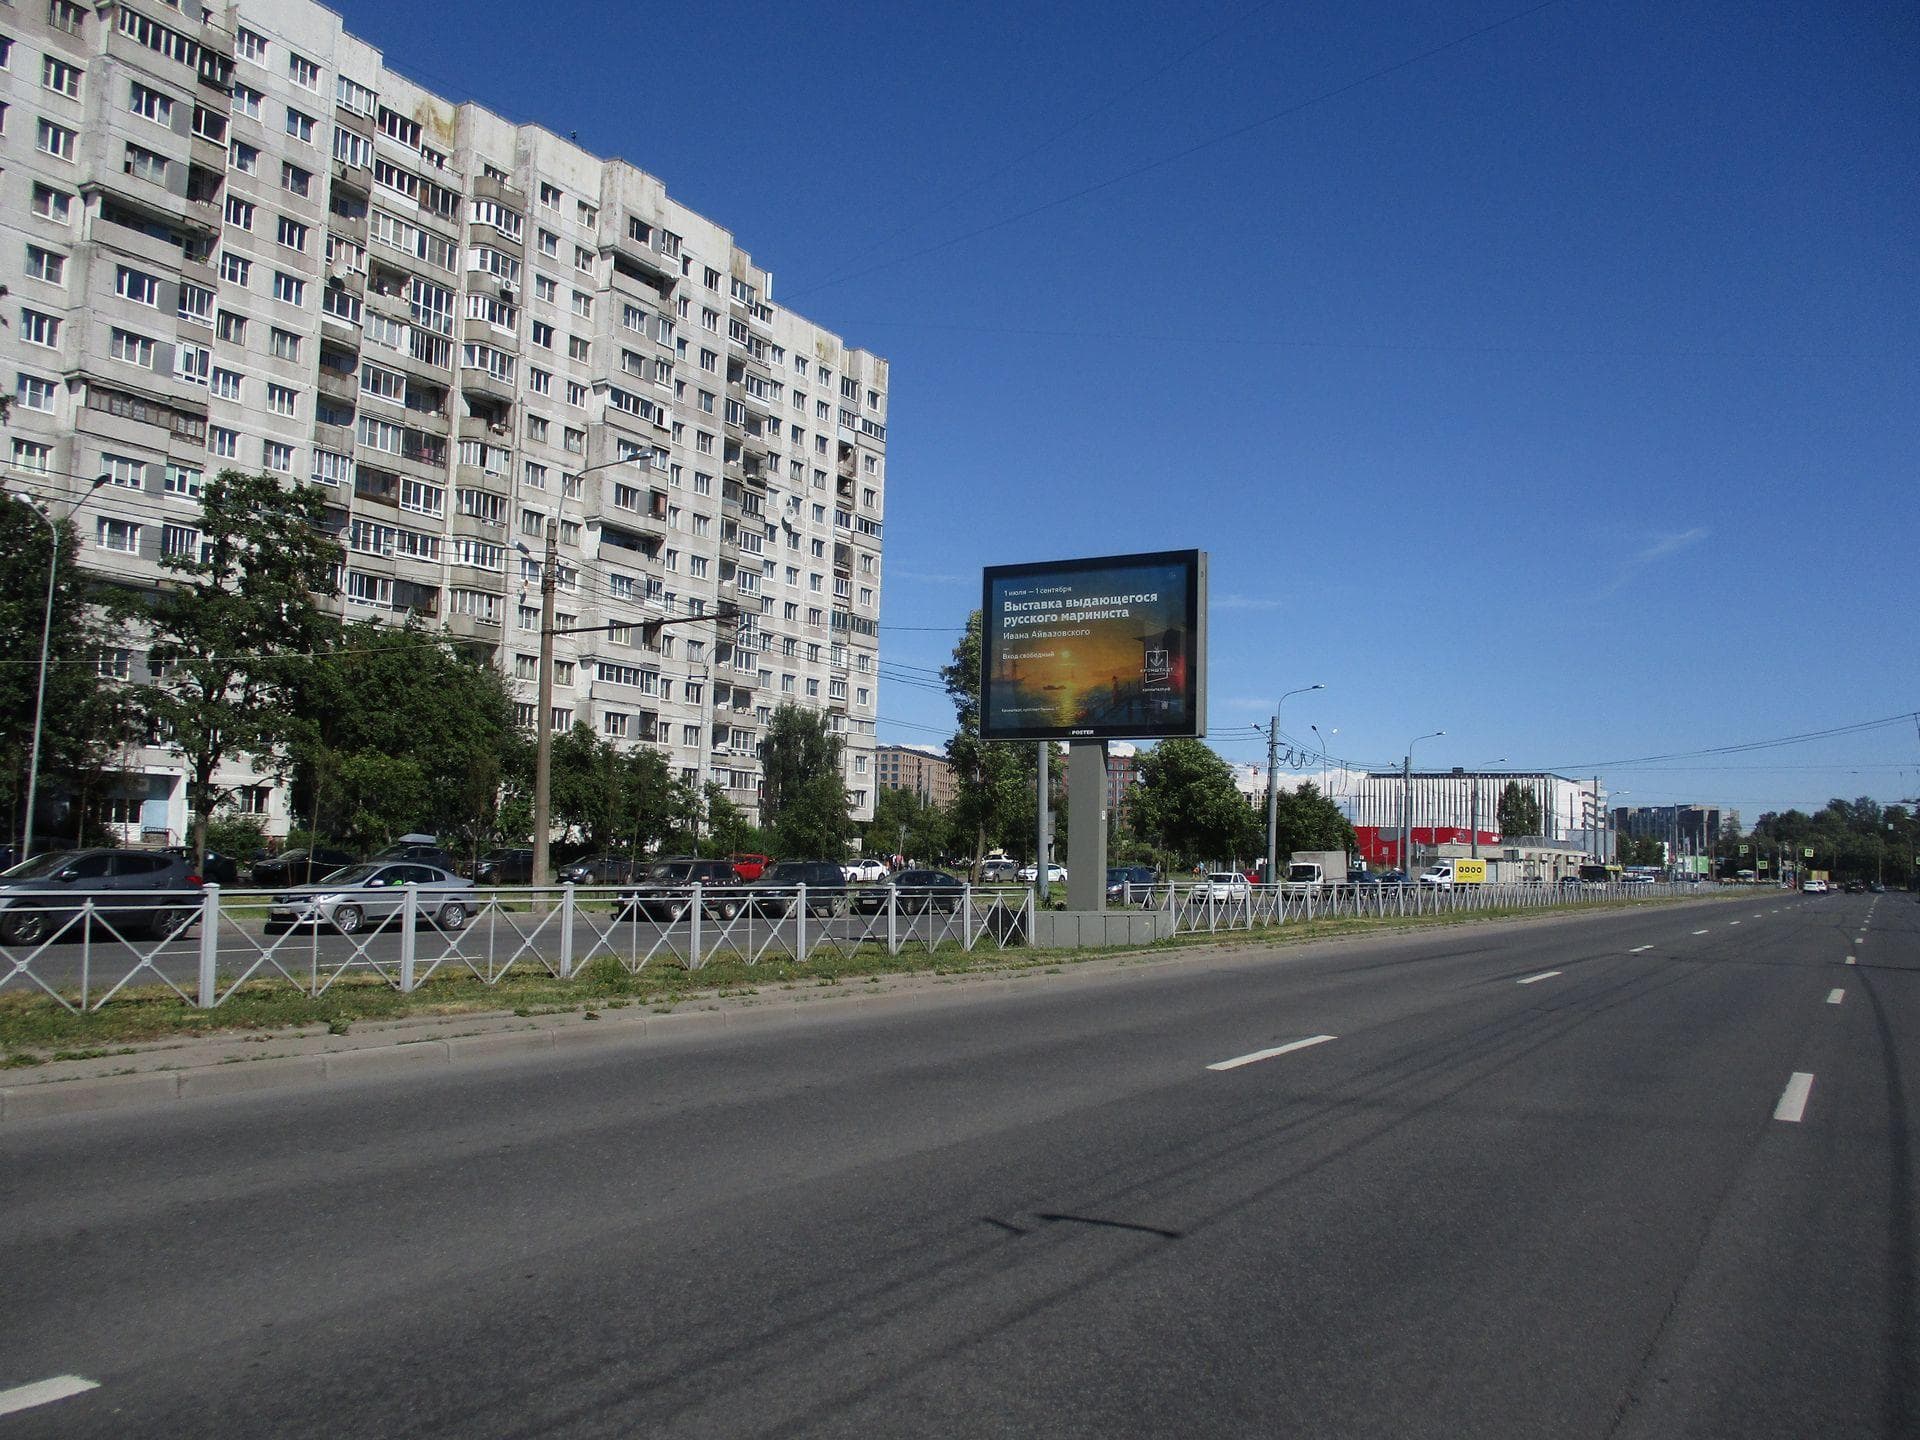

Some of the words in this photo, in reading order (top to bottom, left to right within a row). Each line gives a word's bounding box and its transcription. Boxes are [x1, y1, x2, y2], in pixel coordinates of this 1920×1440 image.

[1039, 586, 1072, 595] сентября
[1004, 600, 1063, 612] Выставка
[1066, 592, 1158, 608] выдающегося
[1003, 614, 1057, 627] русского
[1061, 609, 1129, 623] мариниста
[1003, 632, 1028, 640] Ивана
[1032, 629, 1090, 639] Айвазовского
[1002, 652, 1018, 661] Вход
[1018, 651, 1055, 660] свободный
